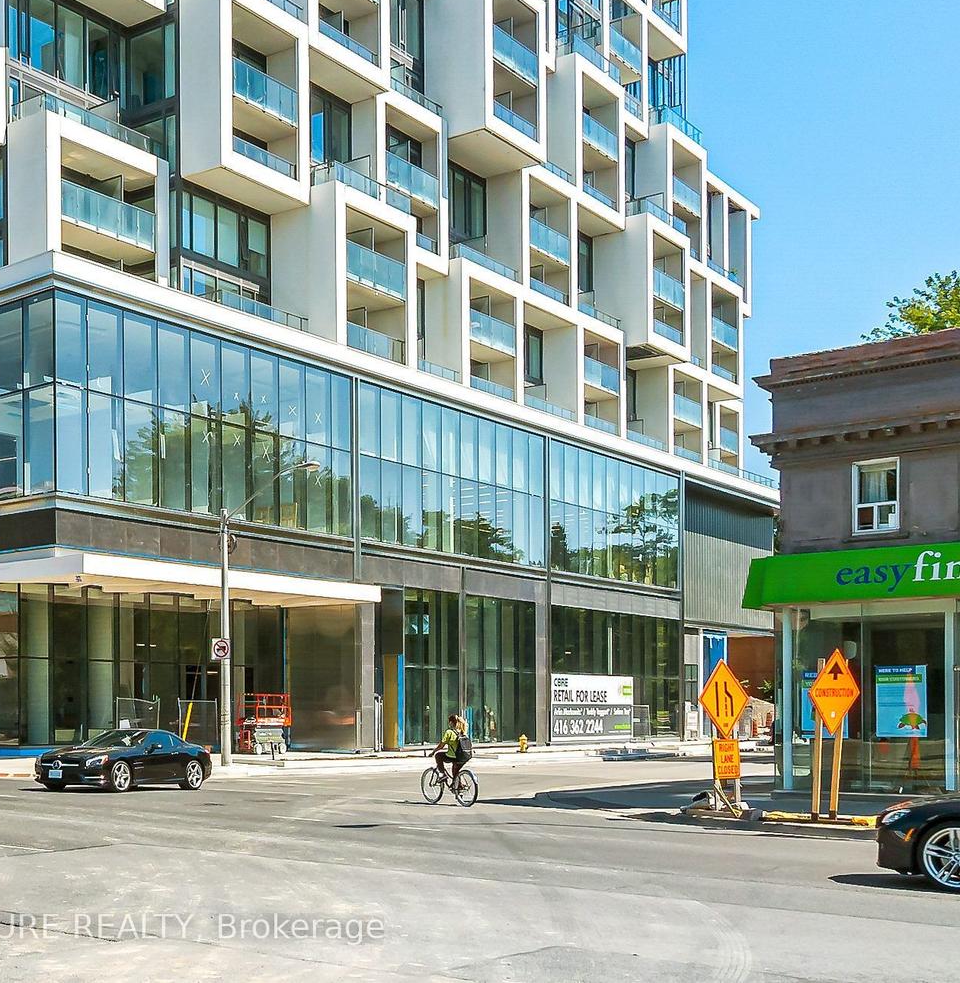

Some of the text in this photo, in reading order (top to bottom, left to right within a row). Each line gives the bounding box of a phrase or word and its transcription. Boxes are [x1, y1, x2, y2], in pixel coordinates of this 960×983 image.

[553, 677, 568, 687] CBRE
[553, 689, 607, 703] RETAIL FOR LEASE
[814, 687, 854, 698] CONSTRUCTION
[553, 718, 604, 735] 416 362 2244
[718, 743, 735, 753] RIGHT
[720, 754, 734, 764] LANE
[717, 765, 738, 775] CLOSED
